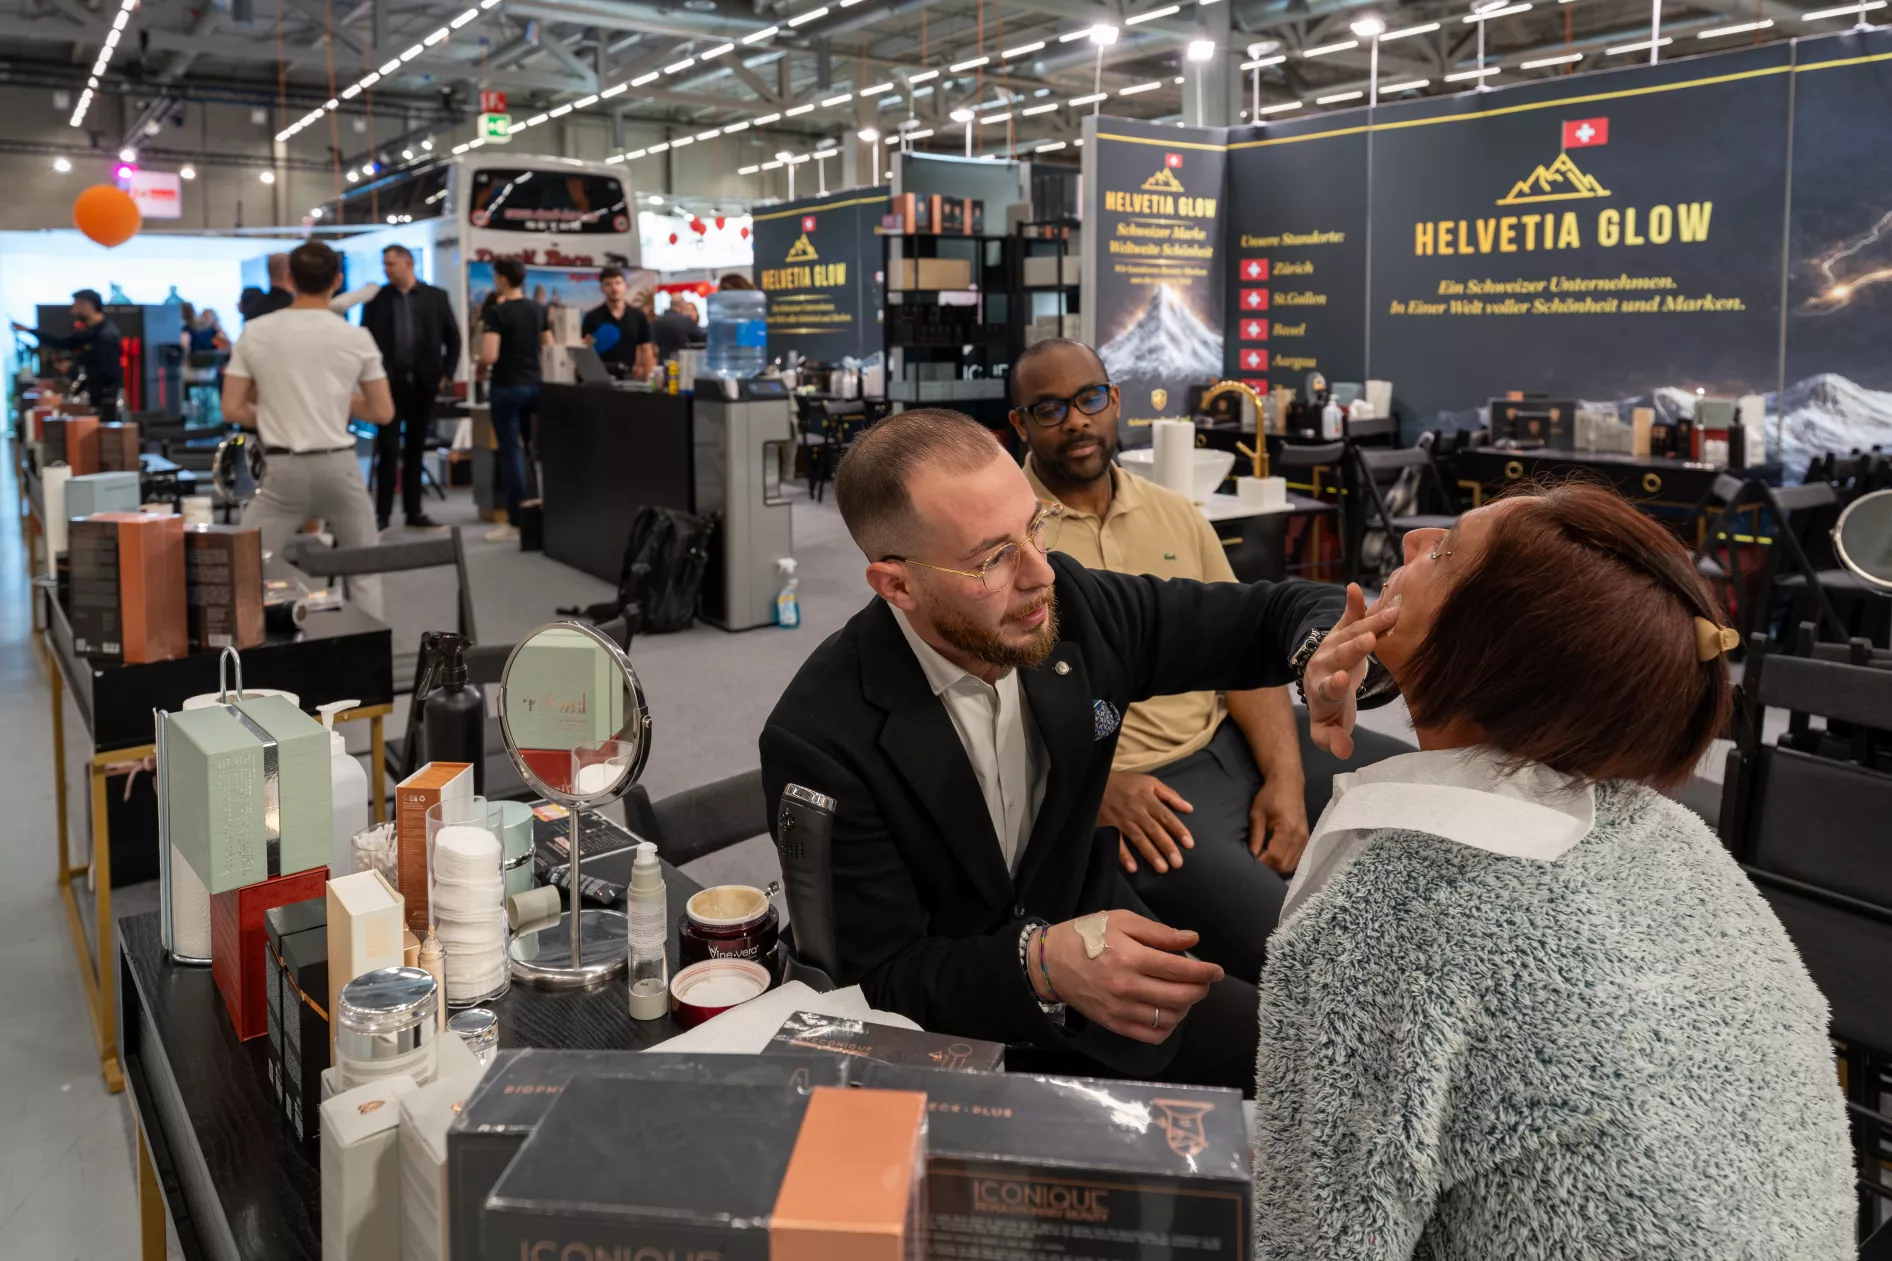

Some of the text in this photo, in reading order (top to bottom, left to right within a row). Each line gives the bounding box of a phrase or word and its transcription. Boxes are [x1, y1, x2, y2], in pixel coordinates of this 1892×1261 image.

[1105, 190, 1217, 218] HELVETIA GLOW
[1415, 201, 1713, 256] HELVETIA GLOW
[1240, 233, 1280, 248] Unsere
[761, 262, 847, 290] HELVETIA GLOW
[1272, 260, 1314, 276] Zürich
[1438, 273, 1678, 295] Ein Schweizer Unternehmen.
[1407, 300, 1448, 315] Einer
[1449, 299, 1483, 315] Welt
[1485, 298, 1530, 315] voller
[1531, 296, 1619, 315] Schönheit
[1620, 295, 1661, 313] und
[1661, 293, 1746, 313] Marken.
[1272, 322, 1307, 337] Basel
[1272, 354, 1317, 371] Aargau
[972, 1104, 1013, 1118] PLUS
[974, 1180, 1109, 1211] ICONIQUE
